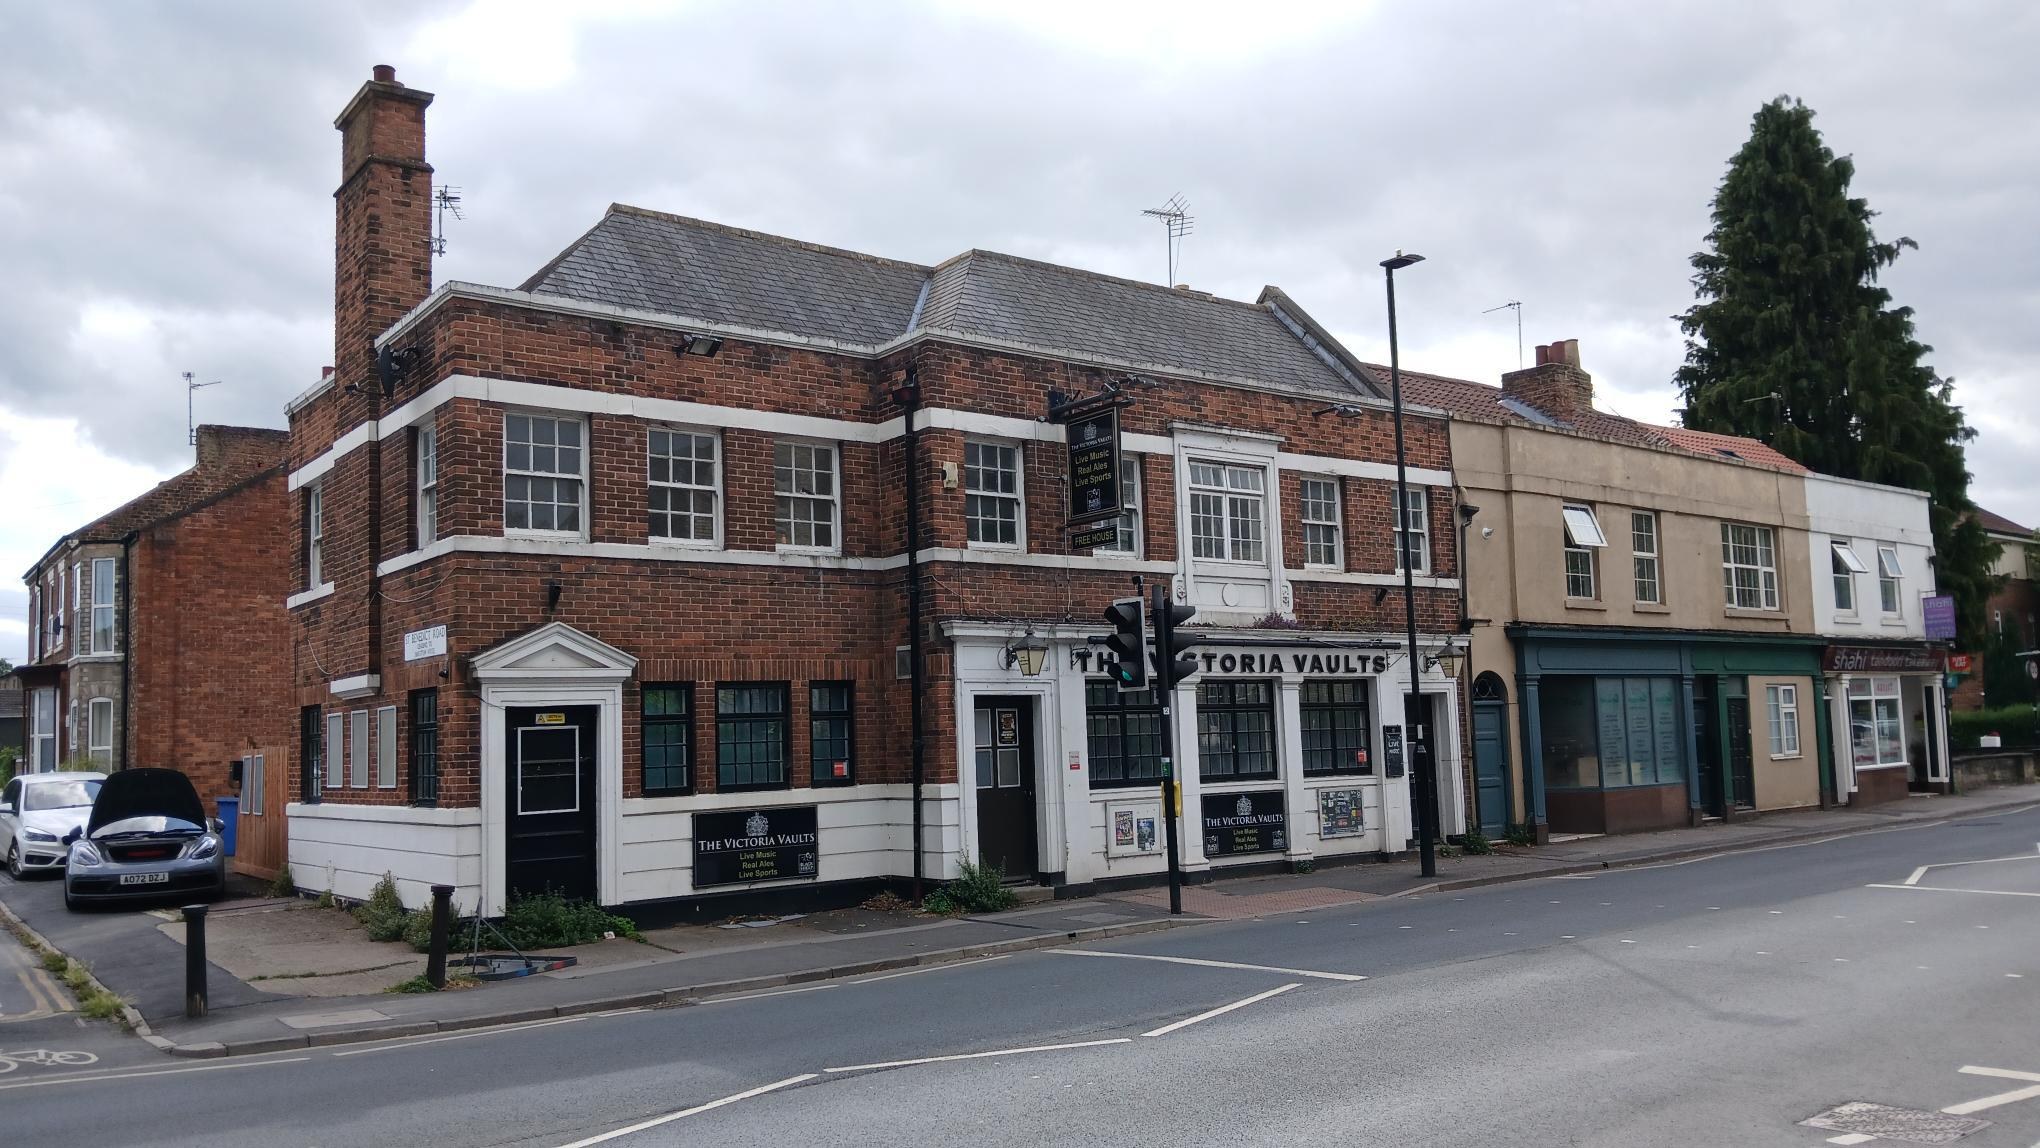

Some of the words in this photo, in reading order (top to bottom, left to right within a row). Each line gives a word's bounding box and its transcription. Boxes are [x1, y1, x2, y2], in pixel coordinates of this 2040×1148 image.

[1075, 455, 1089, 465] Live
[1090, 450, 1110, 461] Music
[1077, 464, 1092, 476] Real
[1093, 462, 1108, 471] Ales
[1075, 478, 1089, 487] Live
[1090, 472, 1112, 484] Sports
[1074, 533, 1091, 546] FREE
[1092, 530, 1114, 542] HOUSE
[1075, 651, 1115, 673] TH
[1148, 652, 1284, 673] VTORIA
[1292, 652, 1387, 673] VAULTS
[1205, 818, 1222, 828] THE
[1222, 815, 1258, 827] VICTORIA
[1257, 813, 1284, 823] VAULTS
[698, 840, 722, 852] THE
[723, 836, 776, 849] VICTORIA
[777, 832, 815, 845] VAULTS
[1244, 843, 1260, 851] Sports
[739, 852, 755, 860] Live
[755, 850, 777, 859] Music
[742, 861, 758, 870] Real
[759, 860, 775, 868] Ales
[148, 874, 165, 882] DZJ
[739, 870, 755, 879] Live
[755, 869, 778, 879] Sports
